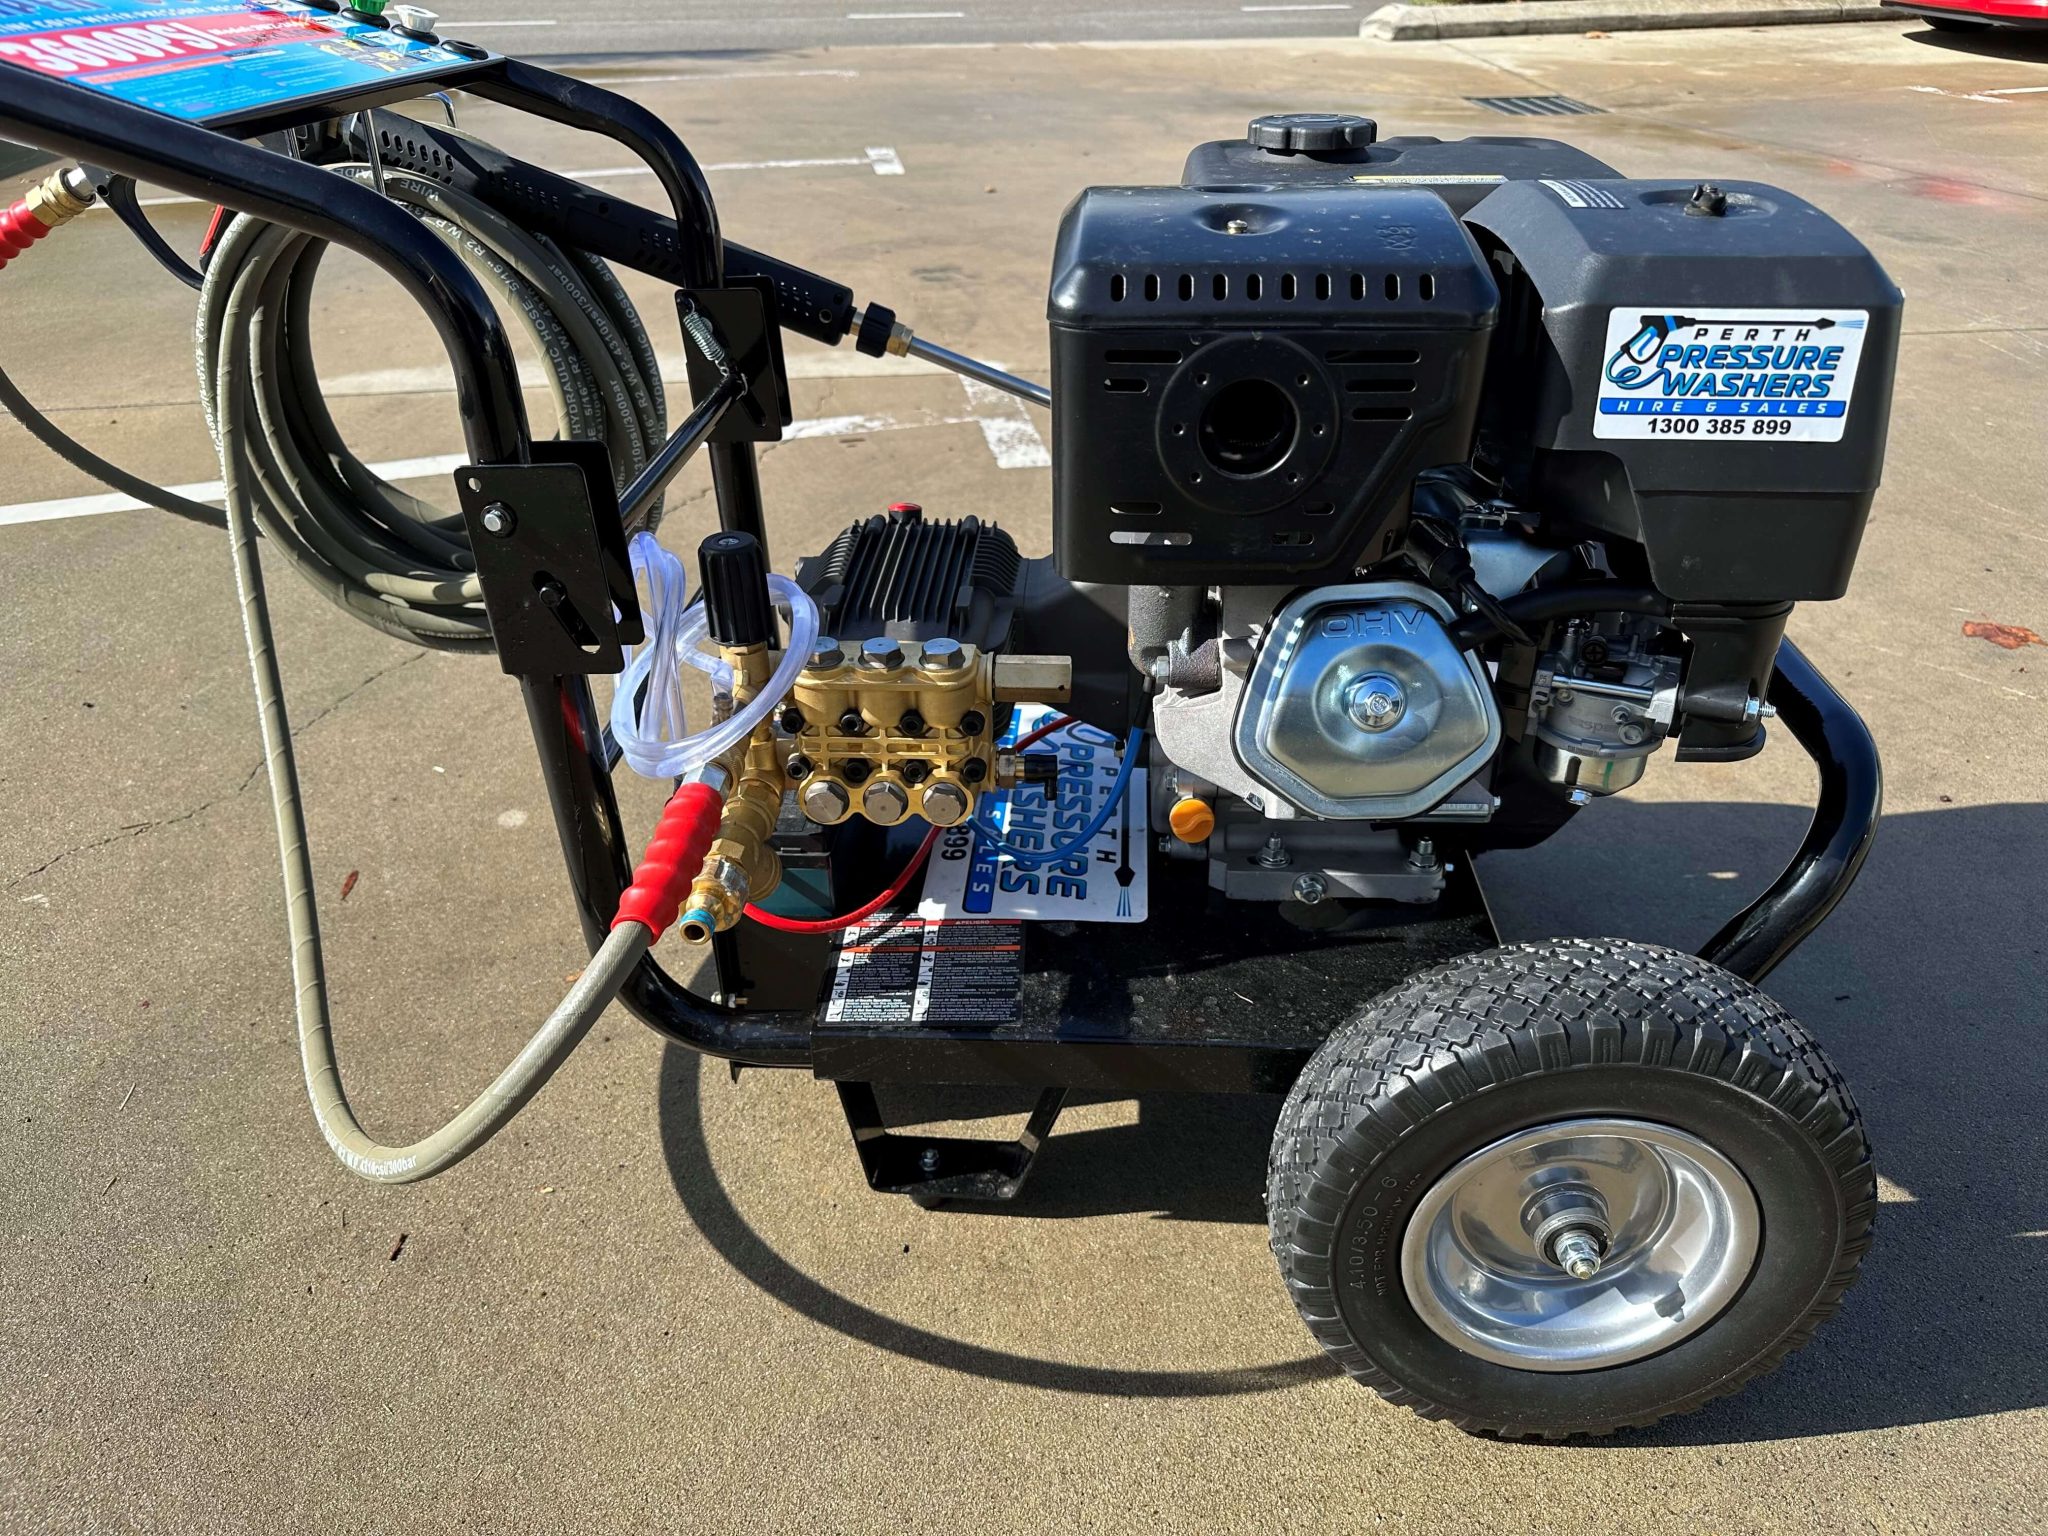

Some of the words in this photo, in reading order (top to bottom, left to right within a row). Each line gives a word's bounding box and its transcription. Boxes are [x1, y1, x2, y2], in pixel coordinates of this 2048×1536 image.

[0, 22, 237, 72] 3600PSI
[400, 178, 440, 202] WIRE
[465, 237, 486, 257] R2
[548, 263, 623, 357] 4310psi/300bar
[1694, 328, 1811, 342] PERTH
[1656, 344, 1844, 371] PRESSURE
[637, 334, 665, 415] HYDRAULIC
[1659, 369, 1835, 398] WASHERS
[549, 346, 582, 434] HYDRAULIC
[1617, 401, 1684, 413] HIRE
[1705, 402, 1717, 413] &
[1738, 402, 1828, 415] SALES
[609, 379, 645, 475] 310psi/300bar
[1647, 418, 1700, 434] 1300
[1706, 419, 1746, 434] 385
[1752, 420, 1792, 435] 899
[1321, 609, 1425, 638] OHV
[1000, 780, 1046, 895] SHERS
[1349, 1206, 1379, 1289] 4.10/3.50
[1381, 1175, 1398, 1189] 6
[1374, 1250, 1386, 1270] FOR
